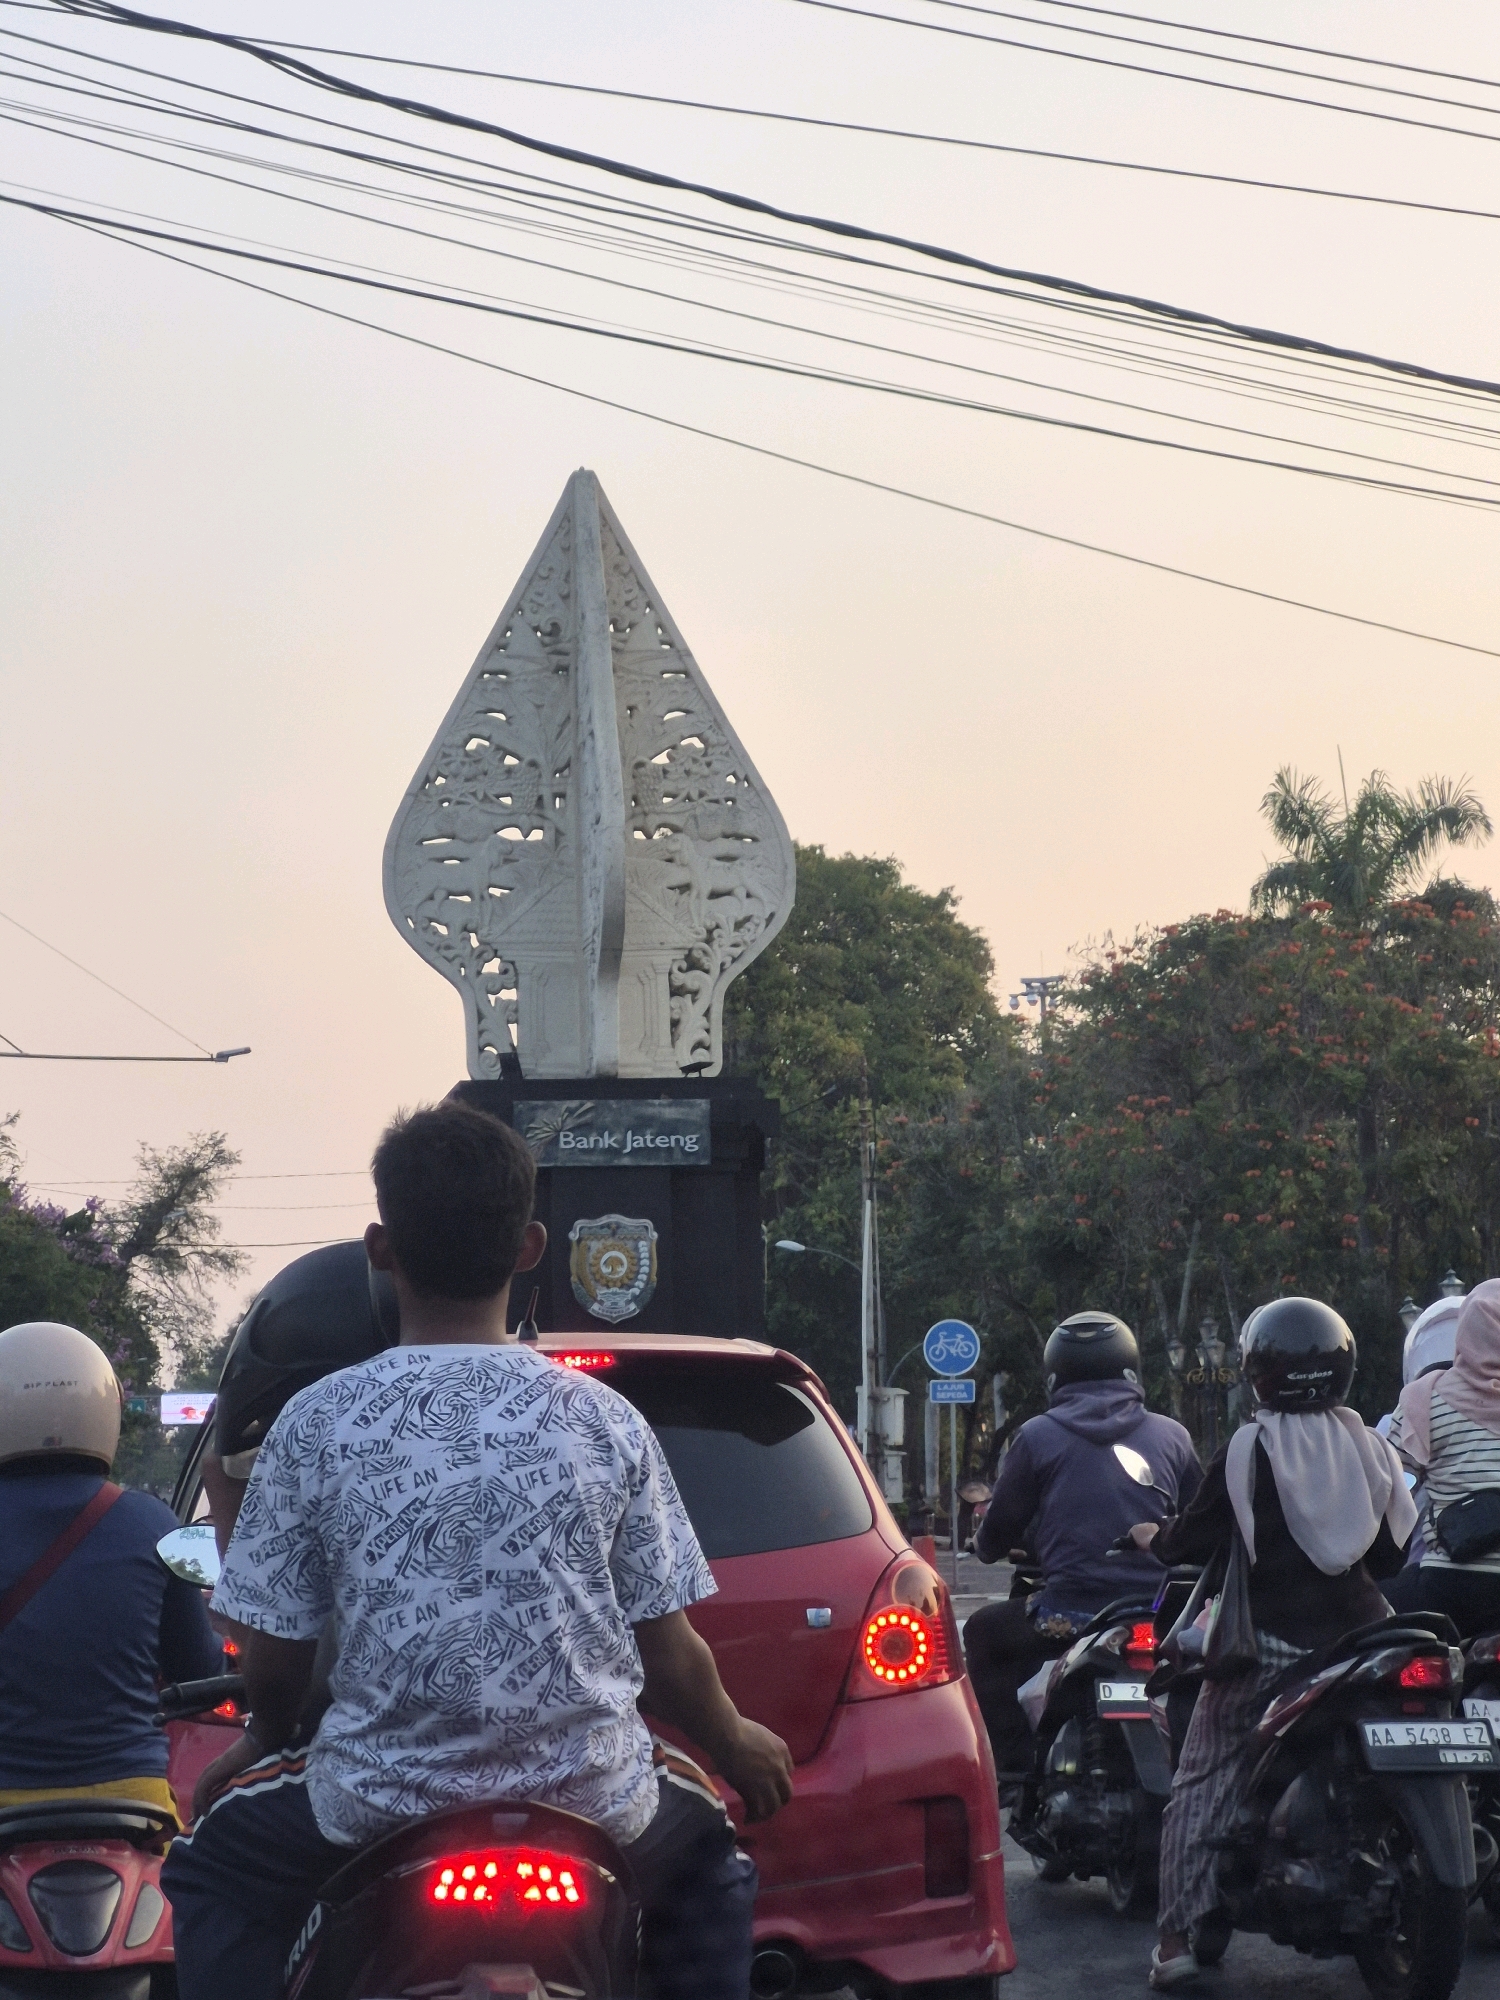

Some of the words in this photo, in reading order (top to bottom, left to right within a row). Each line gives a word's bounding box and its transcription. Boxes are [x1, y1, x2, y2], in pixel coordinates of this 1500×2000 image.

[558, 1130, 619, 1149] Bank
[622, 1130, 700, 1154] Jateng
[365, 1357, 400, 1376] LIFE
[505, 1356, 541, 1370] LIFE
[936, 1391, 968, 1399] SEPEDA
[937, 1383, 965, 1391] LAJUR
[370, 1475, 408, 1502] LIFE
[413, 1467, 439, 1489] AN
[516, 1466, 552, 1492] LIFE
[378, 1610, 409, 1636] LIFE
[416, 1601, 440, 1625] AN
[516, 1602, 552, 1629] LIFE
[557, 1594, 576, 1615] AN
[275, 1614, 298, 1633] AN
[1102, 1684, 1113, 1699] D
[1471, 1702, 1491, 1717] AA
[1371, 1728, 1396, 1746] AA
[1405, 1727, 1452, 1745] 5438
[1463, 1727, 1488, 1744] EZ
[284, 1902, 322, 1985] RIO
